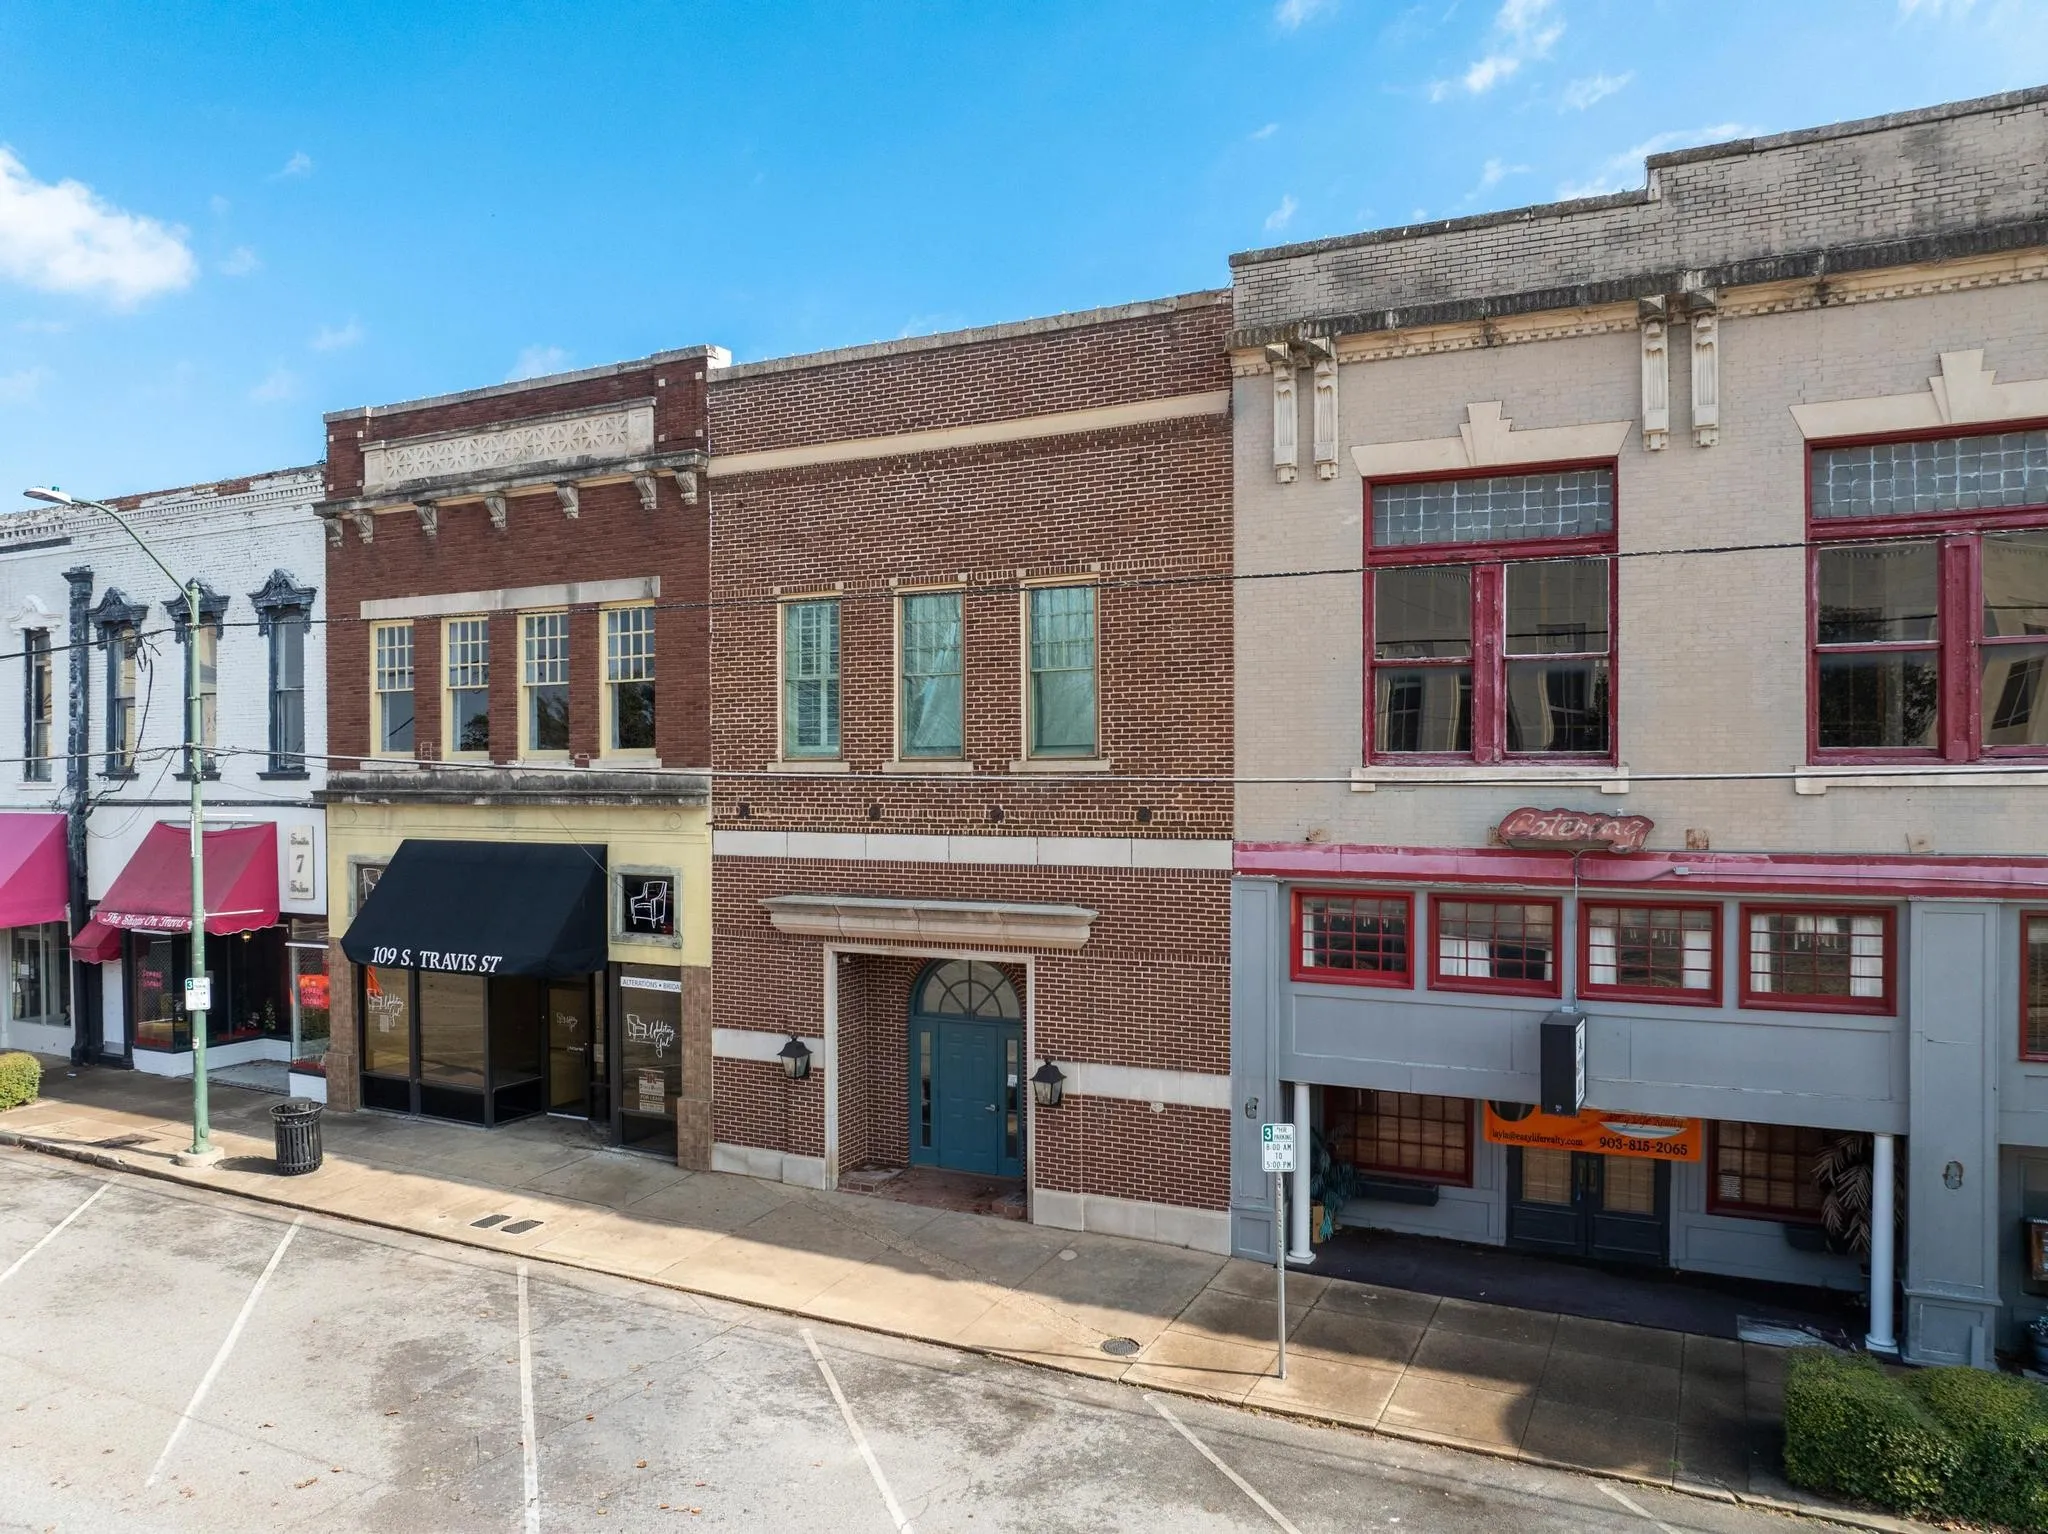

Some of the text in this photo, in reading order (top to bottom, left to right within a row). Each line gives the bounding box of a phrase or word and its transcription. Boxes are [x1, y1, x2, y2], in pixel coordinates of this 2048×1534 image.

[1507, 812, 1646, 849] Catering
[296, 854, 305, 873] 7
[103, 912, 121, 924] The
[144, 915, 158, 927] On
[159, 916, 186, 928] Travis
[371, 946, 503, 973] 109 S. TRAVIS ST
[187, 981, 193, 989] 3
[622, 979, 658, 989] ALTERATIONS
[1264, 1127, 1272, 1140] 3
[1283, 1143, 1292, 1151] AM
[1599, 1136, 1688, 1156] 903-815-2065
[1275, 1152, 1283, 1160] TO
[1266, 1161, 1292, 1169] 5:00 PM
